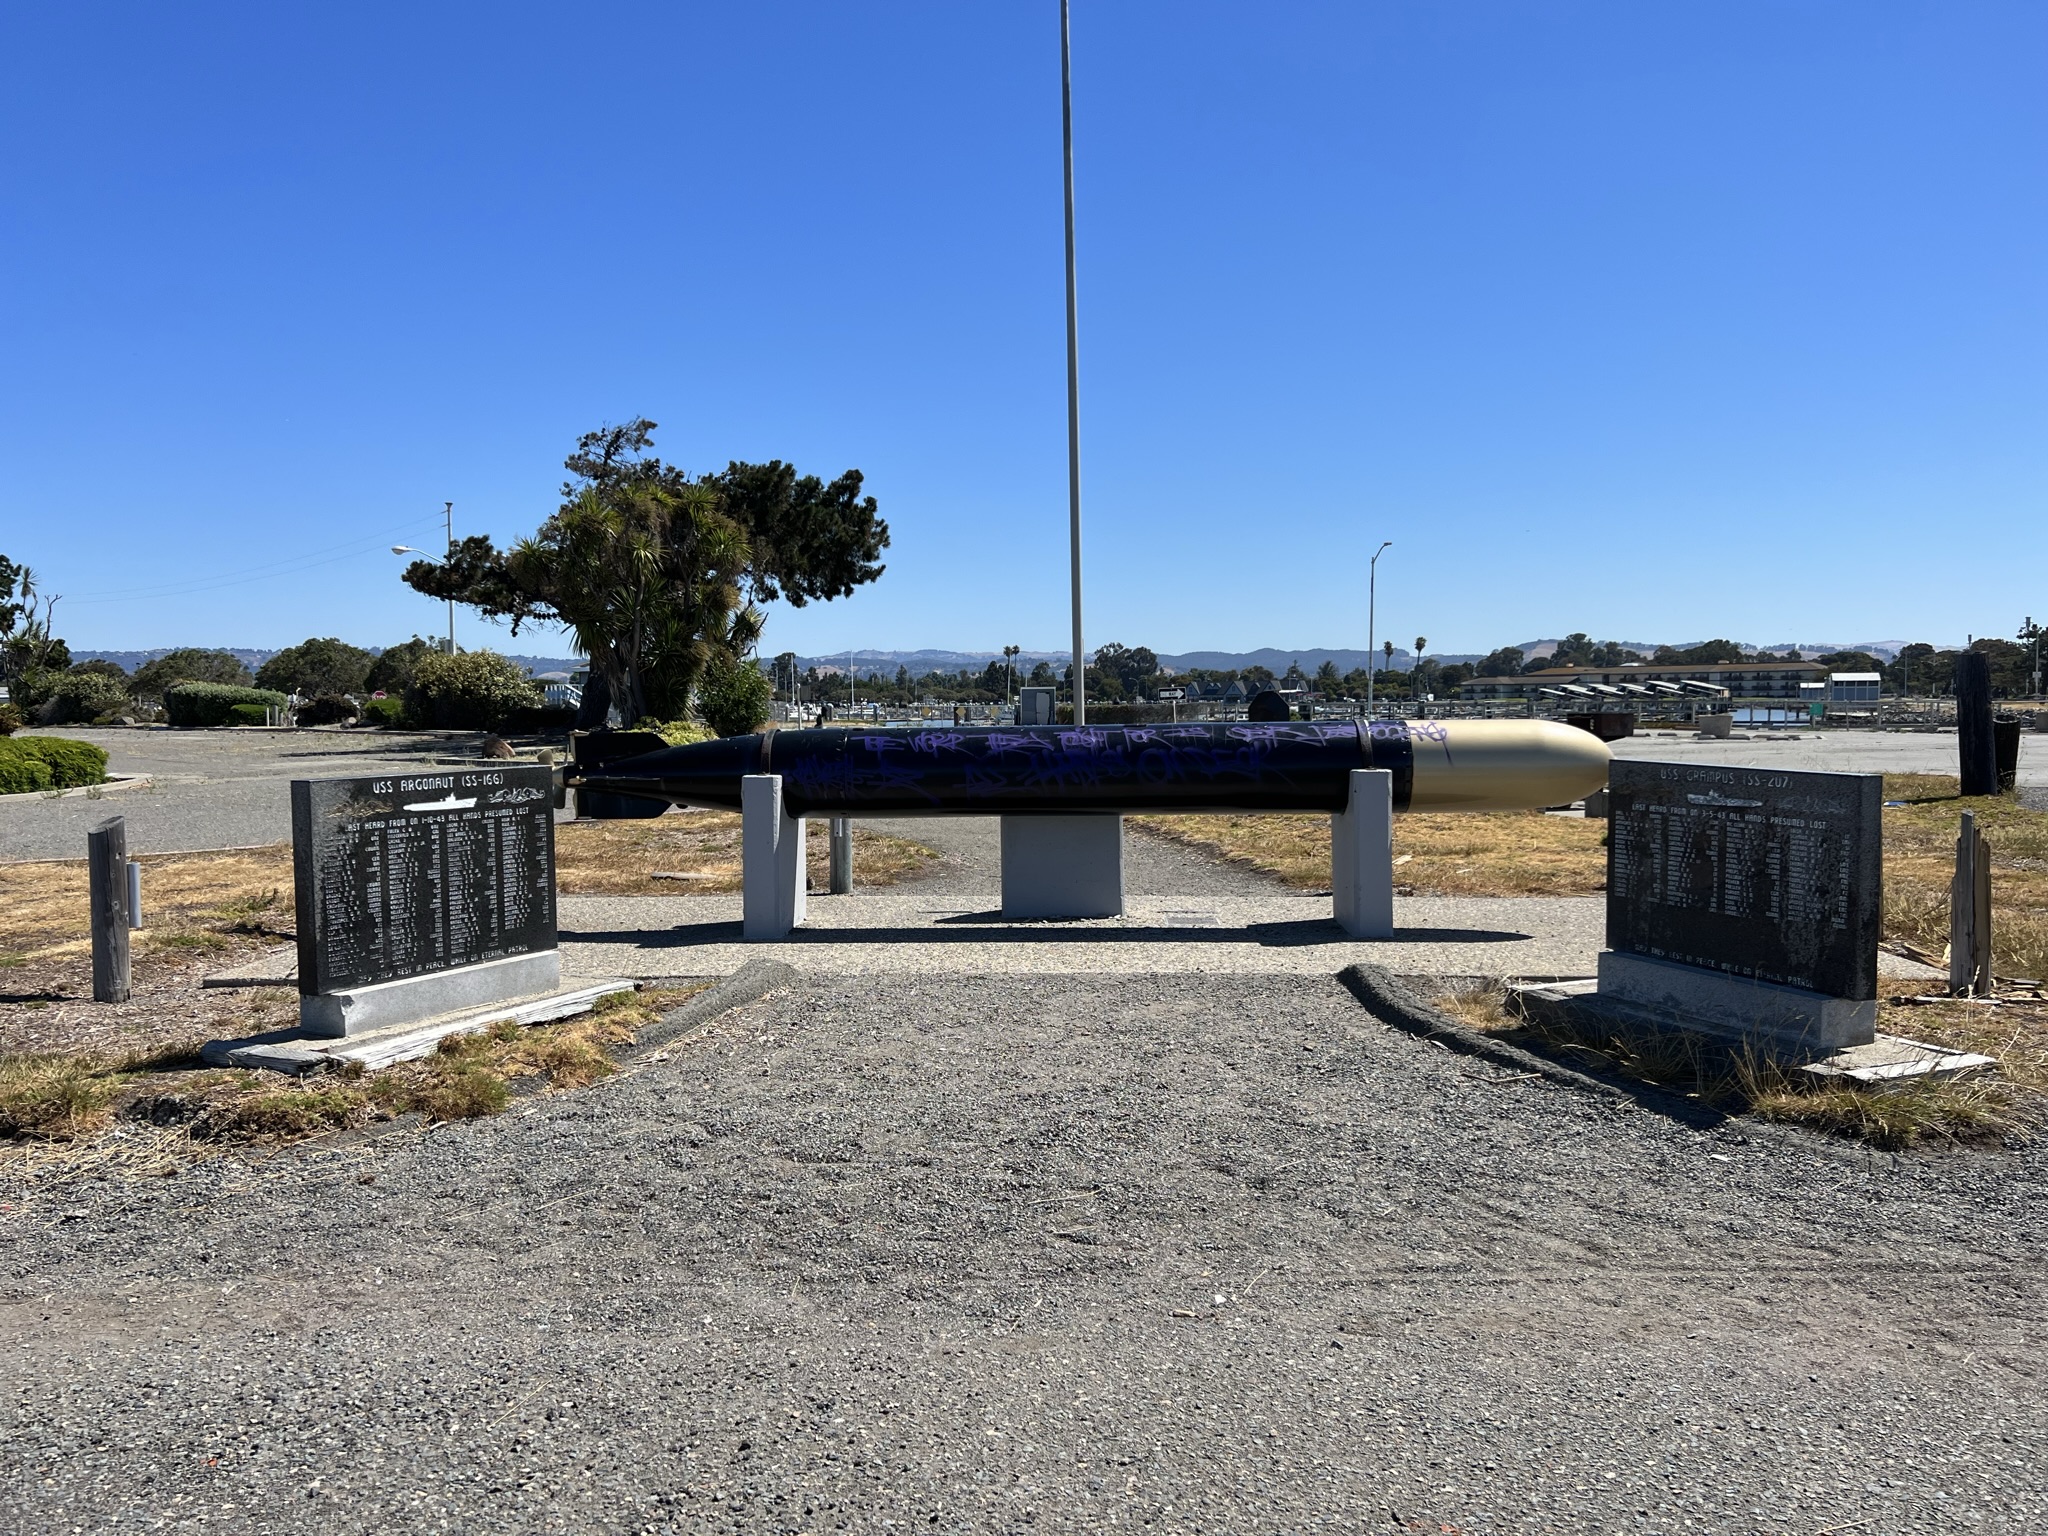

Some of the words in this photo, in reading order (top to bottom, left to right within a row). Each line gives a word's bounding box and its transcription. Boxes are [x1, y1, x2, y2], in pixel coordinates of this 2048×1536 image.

[372, 781, 394, 794] USS
[400, 776, 455, 791] ARGONAUT
[461, 772, 504, 786] (SS-166)
[1660, 768, 1679, 780] USS
[1686, 769, 1735, 784] GRAMPUS
[364, 820, 386, 830] HEARD
[388, 818, 407, 828] FROM
[409, 817, 419, 825] ON
[421, 814, 446, 824] 1-10-43
[448, 814, 460, 822] ALL
[462, 811, 482, 820] HANDS
[484, 808, 514, 818] PRESUMED
[515, 806, 530, 815] LOST
[1631, 803, 1646, 811] LAST
[1648, 805, 1668, 813] HEARD
[1670, 807, 1687, 815] FROM
[1689, 808, 1698, 816] ON
[1729, 812, 1741, 821] ALL
[1744, 814, 1766, 823] HANDS
[1769, 816, 1806, 827] PRESUMED
[1809, 820, 1827, 829] LOST
